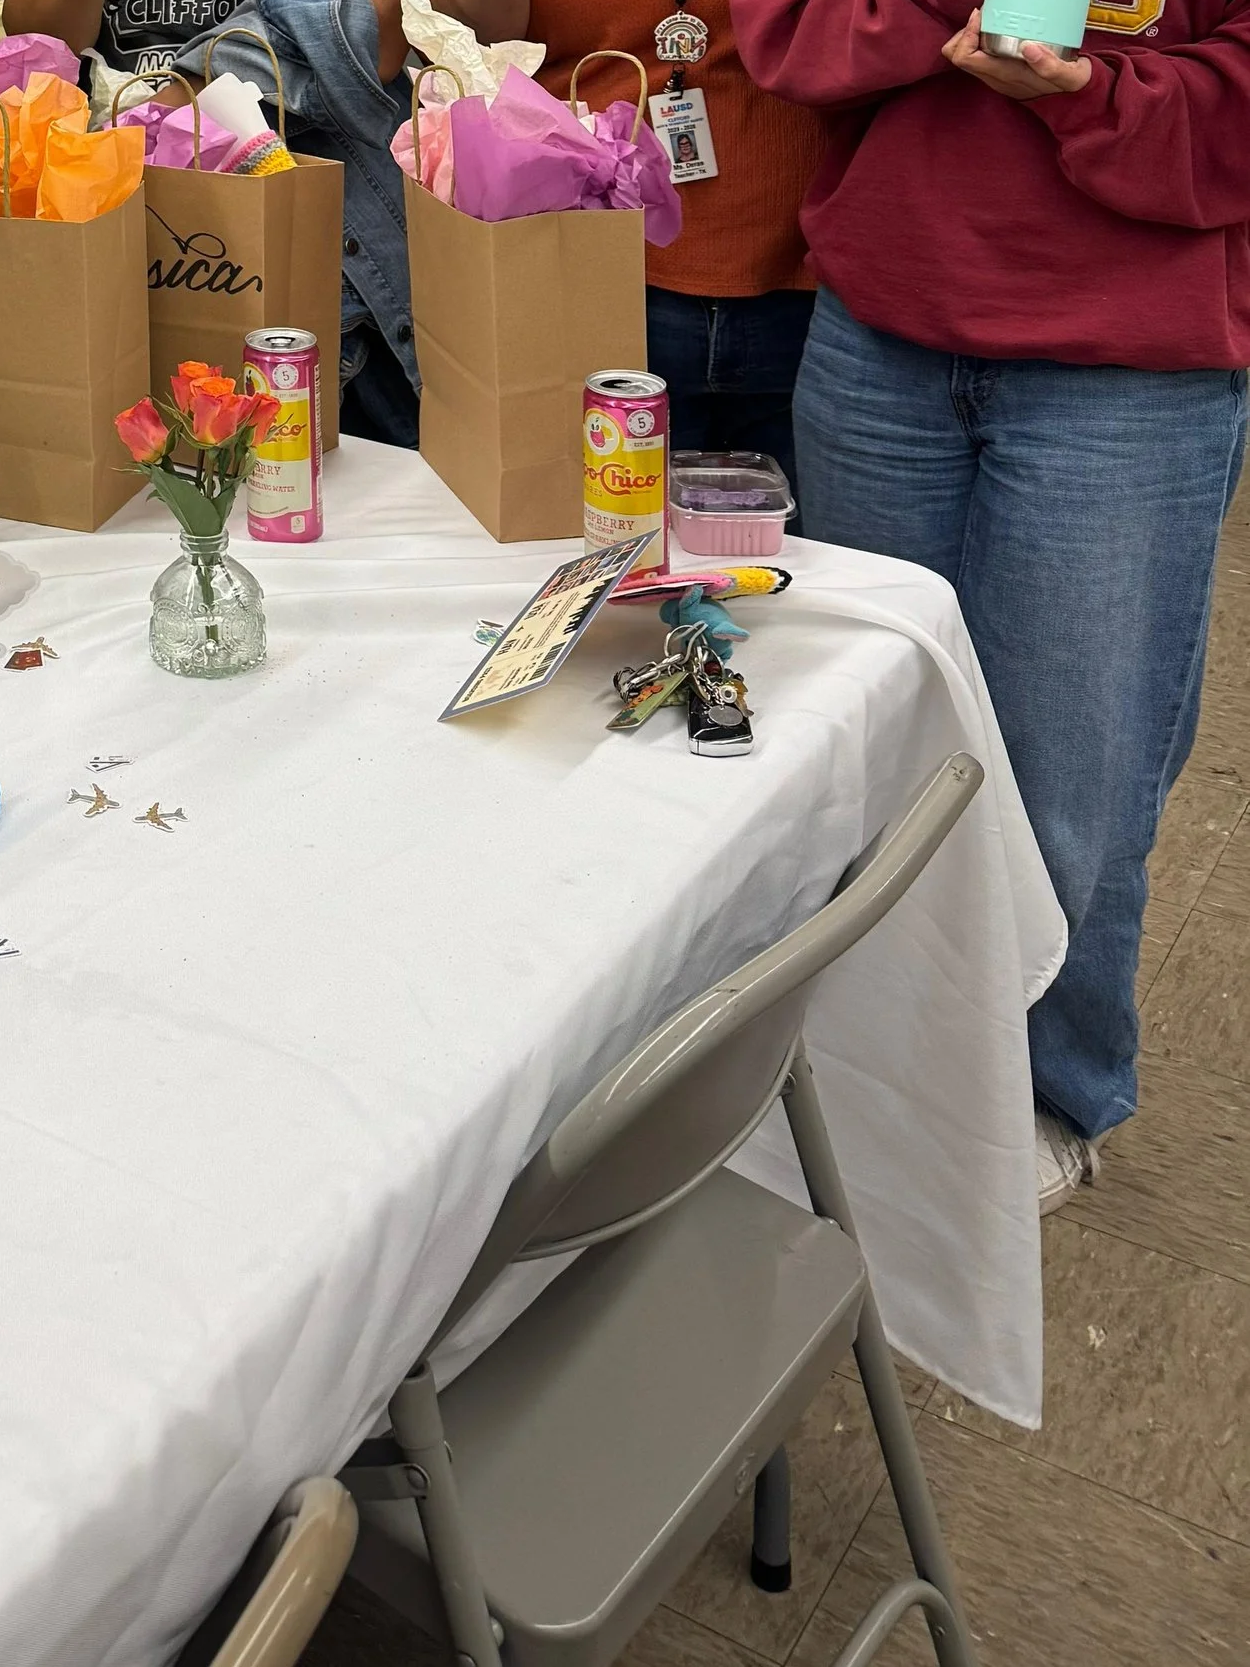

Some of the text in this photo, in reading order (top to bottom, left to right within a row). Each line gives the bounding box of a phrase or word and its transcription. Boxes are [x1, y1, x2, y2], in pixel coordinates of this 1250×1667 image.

[660, 102, 693, 115] LAUSD
[147, 232, 263, 295] sica
[282, 370, 290, 381] 5
[638, 417, 646, 430] 5
[600, 463, 661, 496] Chico
[272, 485, 295, 493] WATER
[585, 507, 635, 531] ASPBERRY
